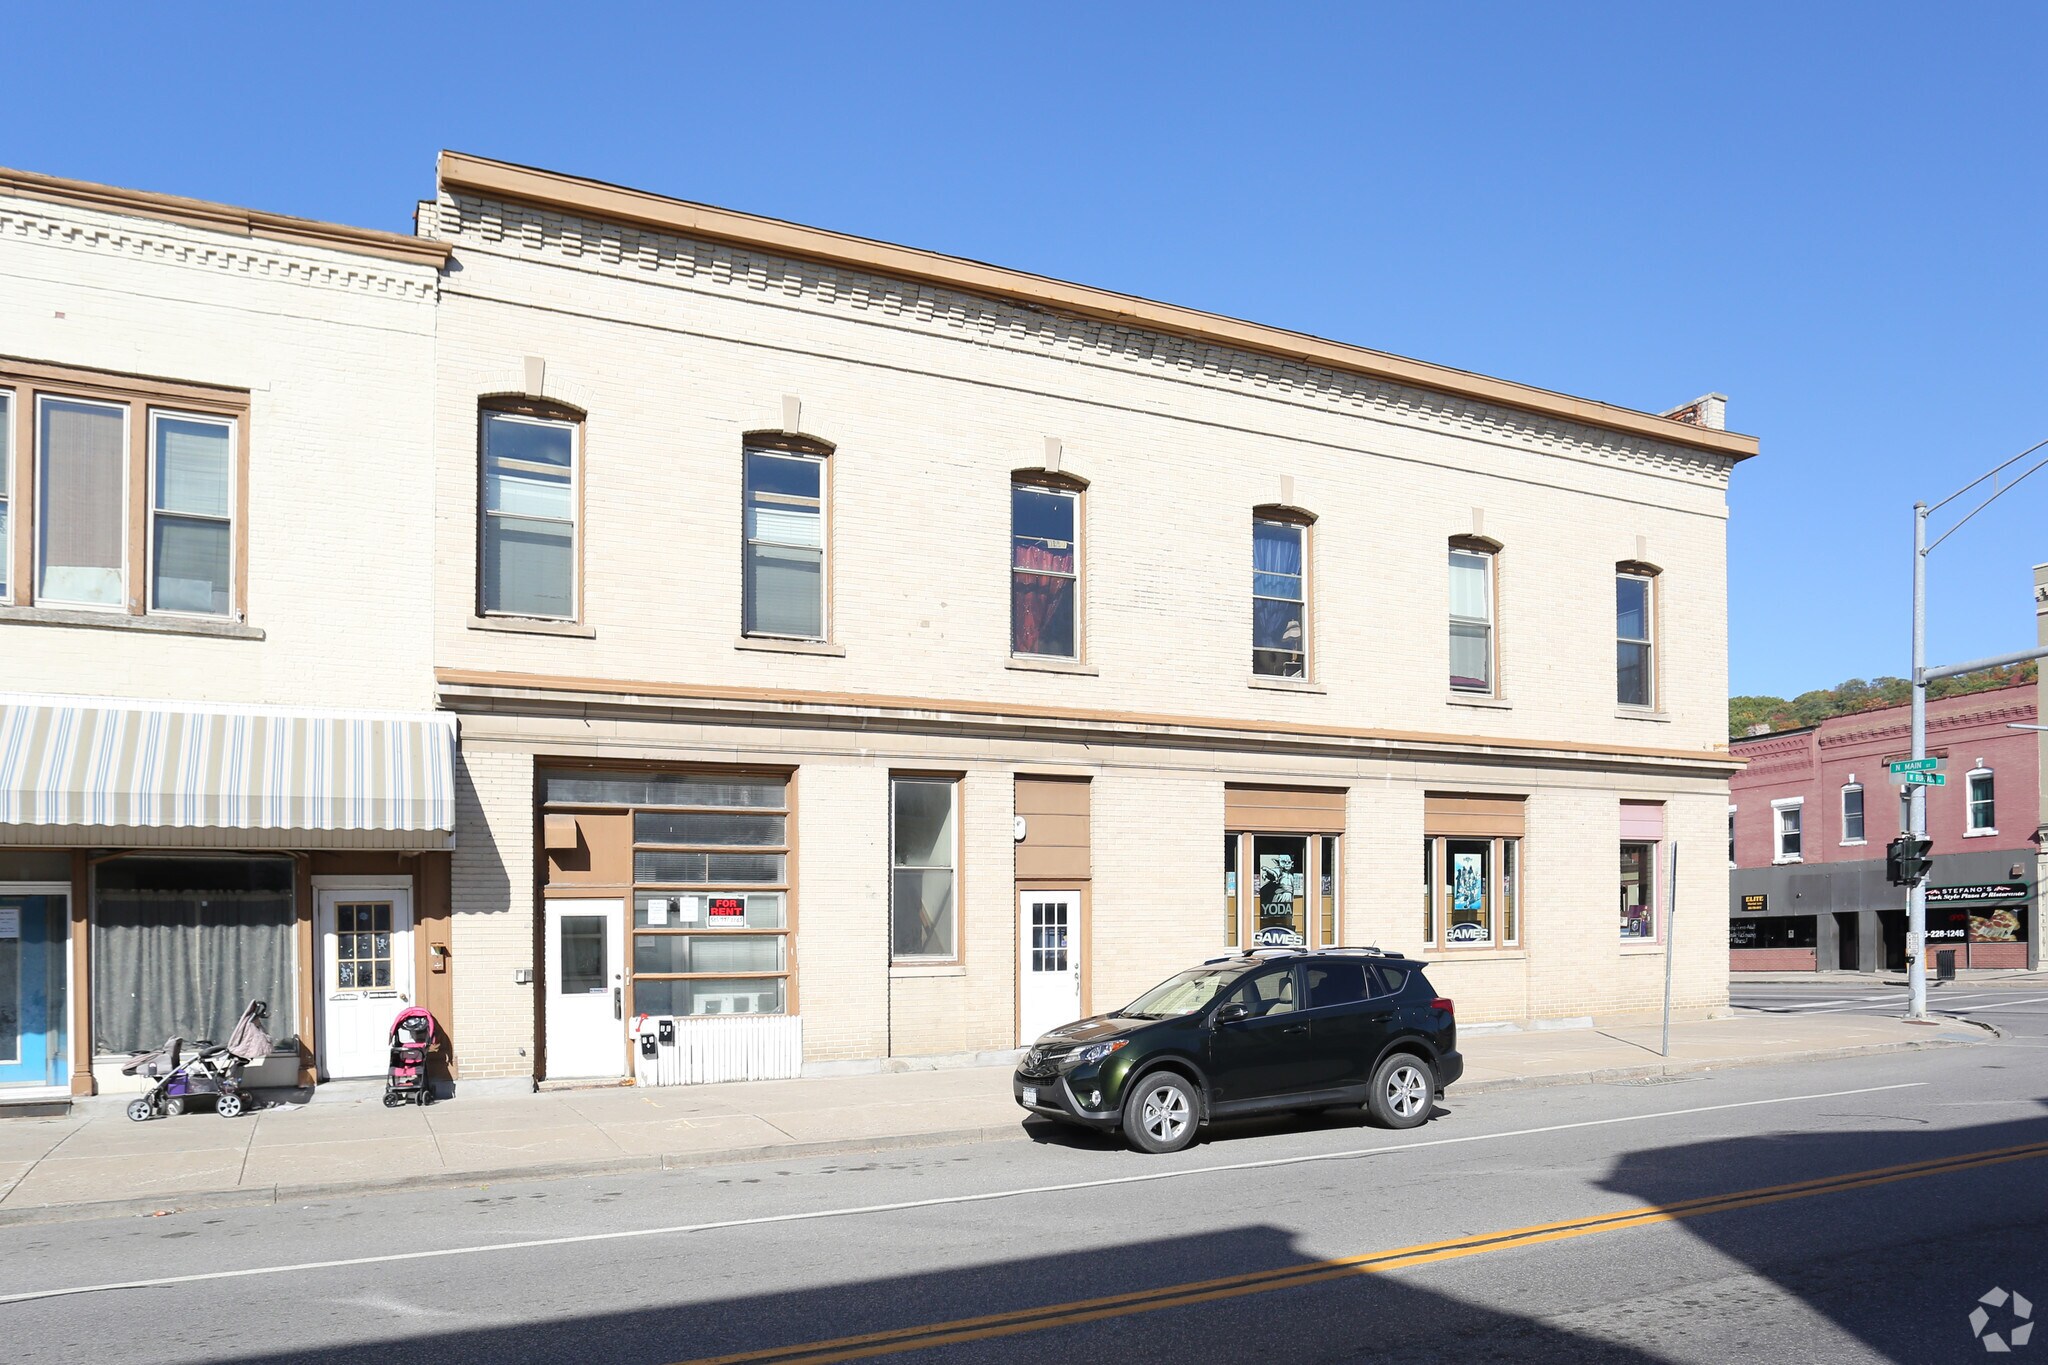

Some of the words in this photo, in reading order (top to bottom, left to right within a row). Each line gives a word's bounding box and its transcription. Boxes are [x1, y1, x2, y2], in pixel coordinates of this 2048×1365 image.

[1904, 762, 1922, 770] MAIN
[1942, 886, 1992, 894] STEFANO'S
[715, 899, 737, 907] FOR
[710, 907, 742, 916] RENT
[1261, 903, 1293, 915] YODA
[1254, 932, 1303, 945] GAMES
[1446, 929, 1488, 939] GAMES
